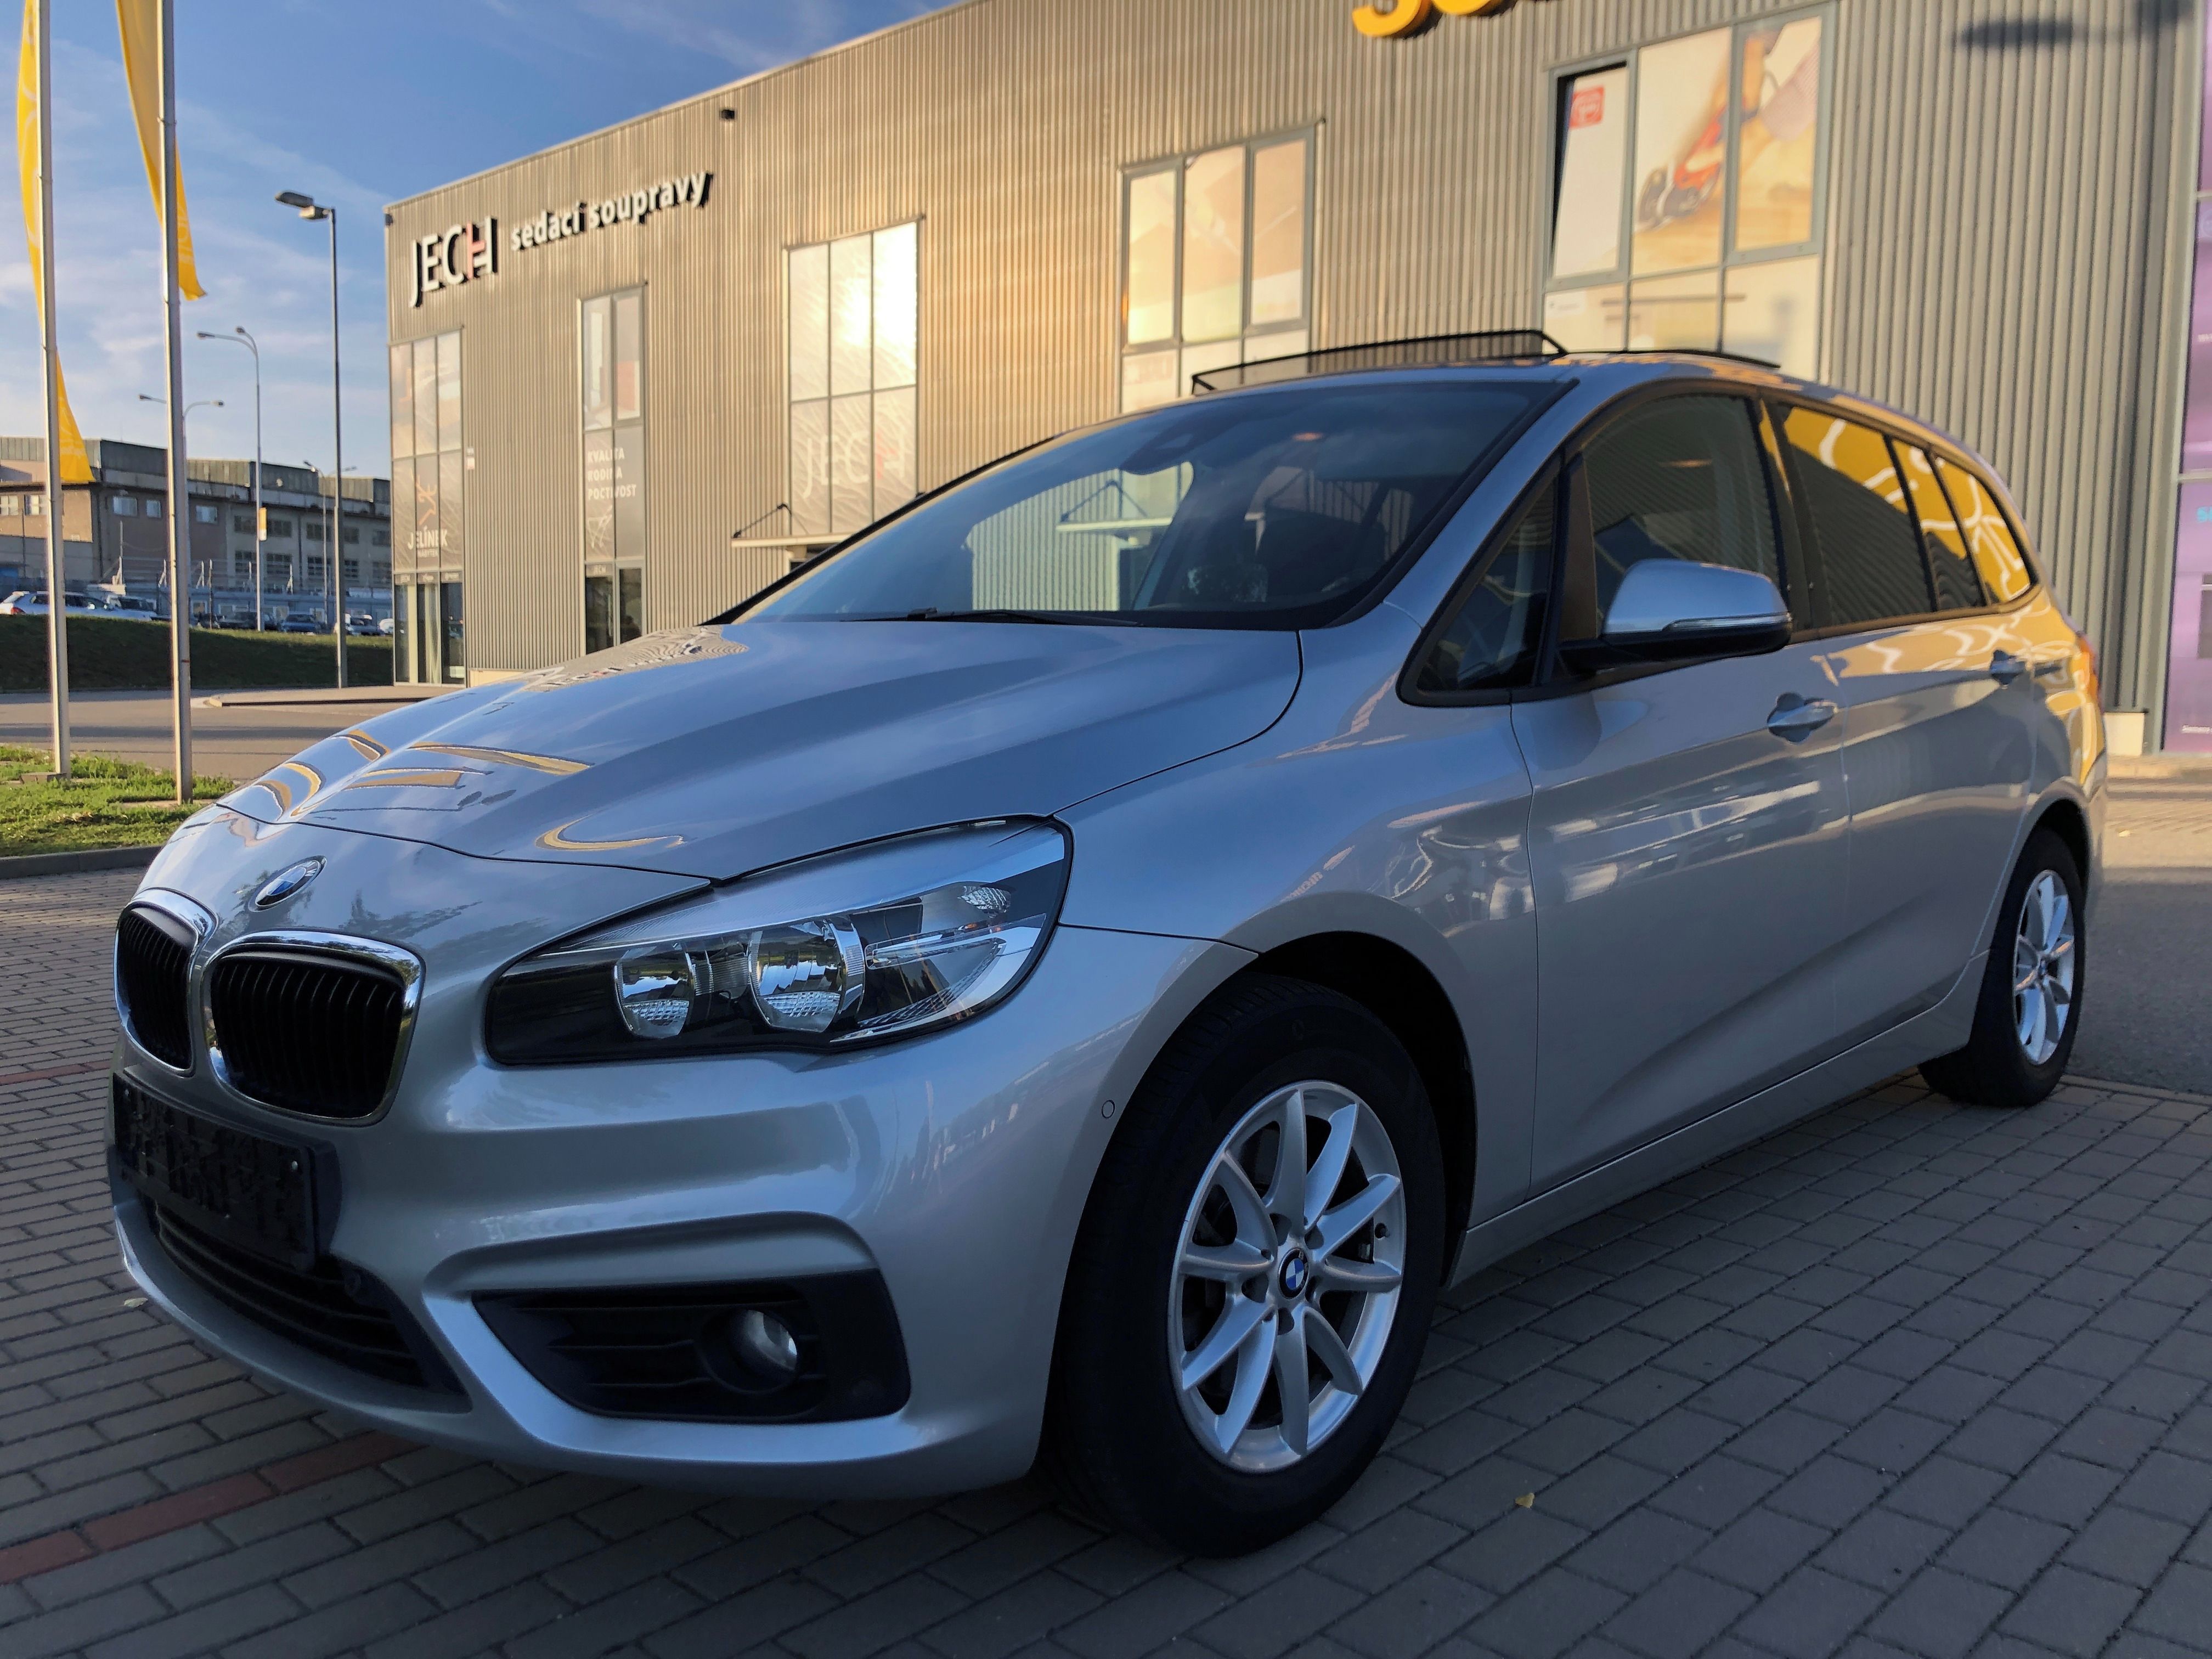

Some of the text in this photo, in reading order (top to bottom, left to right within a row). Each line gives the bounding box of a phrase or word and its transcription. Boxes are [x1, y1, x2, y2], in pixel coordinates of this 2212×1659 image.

[409, 216, 496, 308] JECH
[589, 171, 710, 229] soupravy
[588, 447, 624, 463] KVALITA
